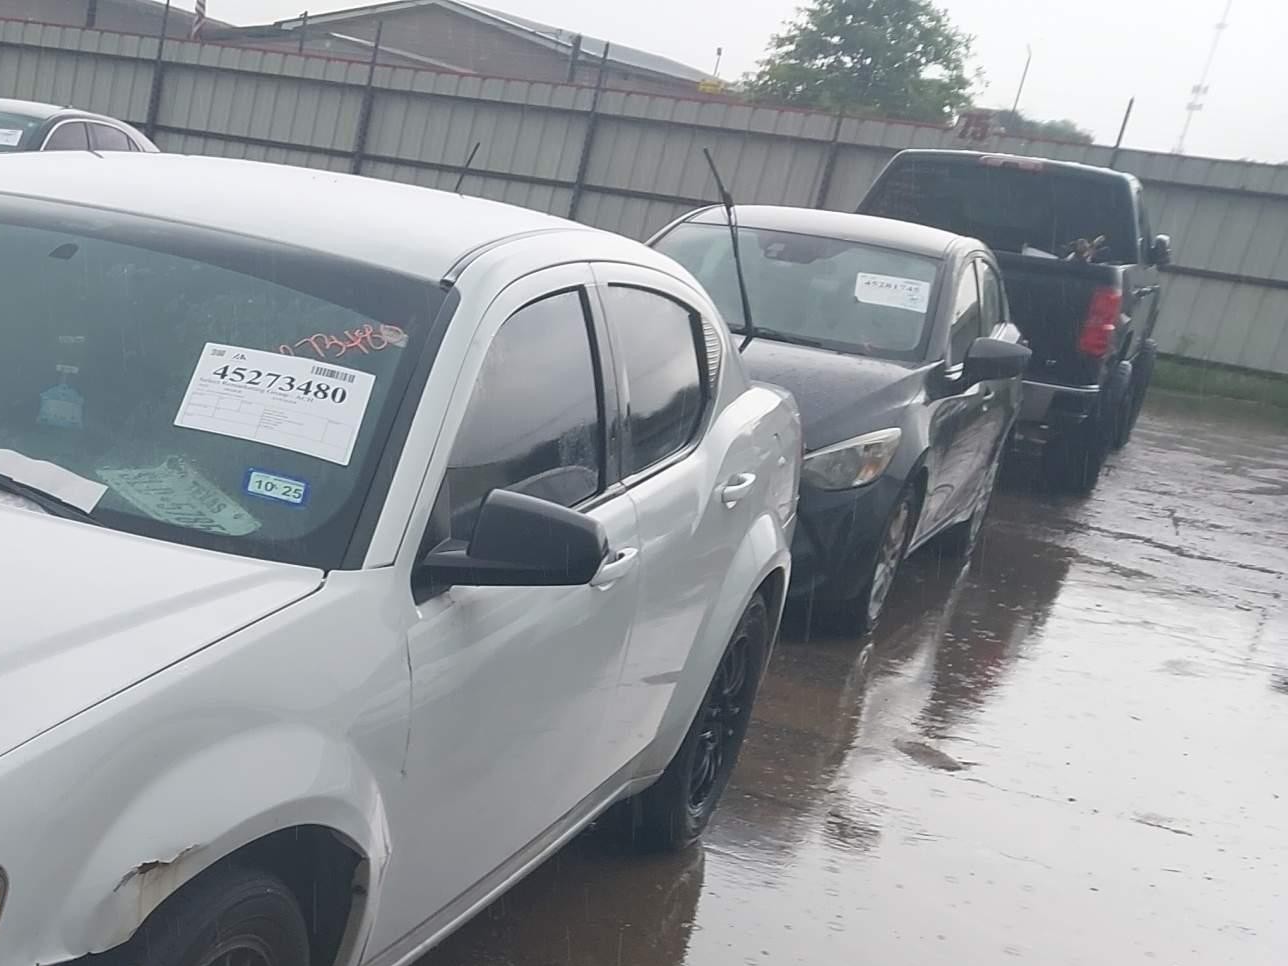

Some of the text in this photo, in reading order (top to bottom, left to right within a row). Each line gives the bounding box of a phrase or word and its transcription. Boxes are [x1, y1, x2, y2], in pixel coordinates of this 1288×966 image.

[213, 364, 347, 404] 45273480
[255, 479, 303, 499] 10 25
